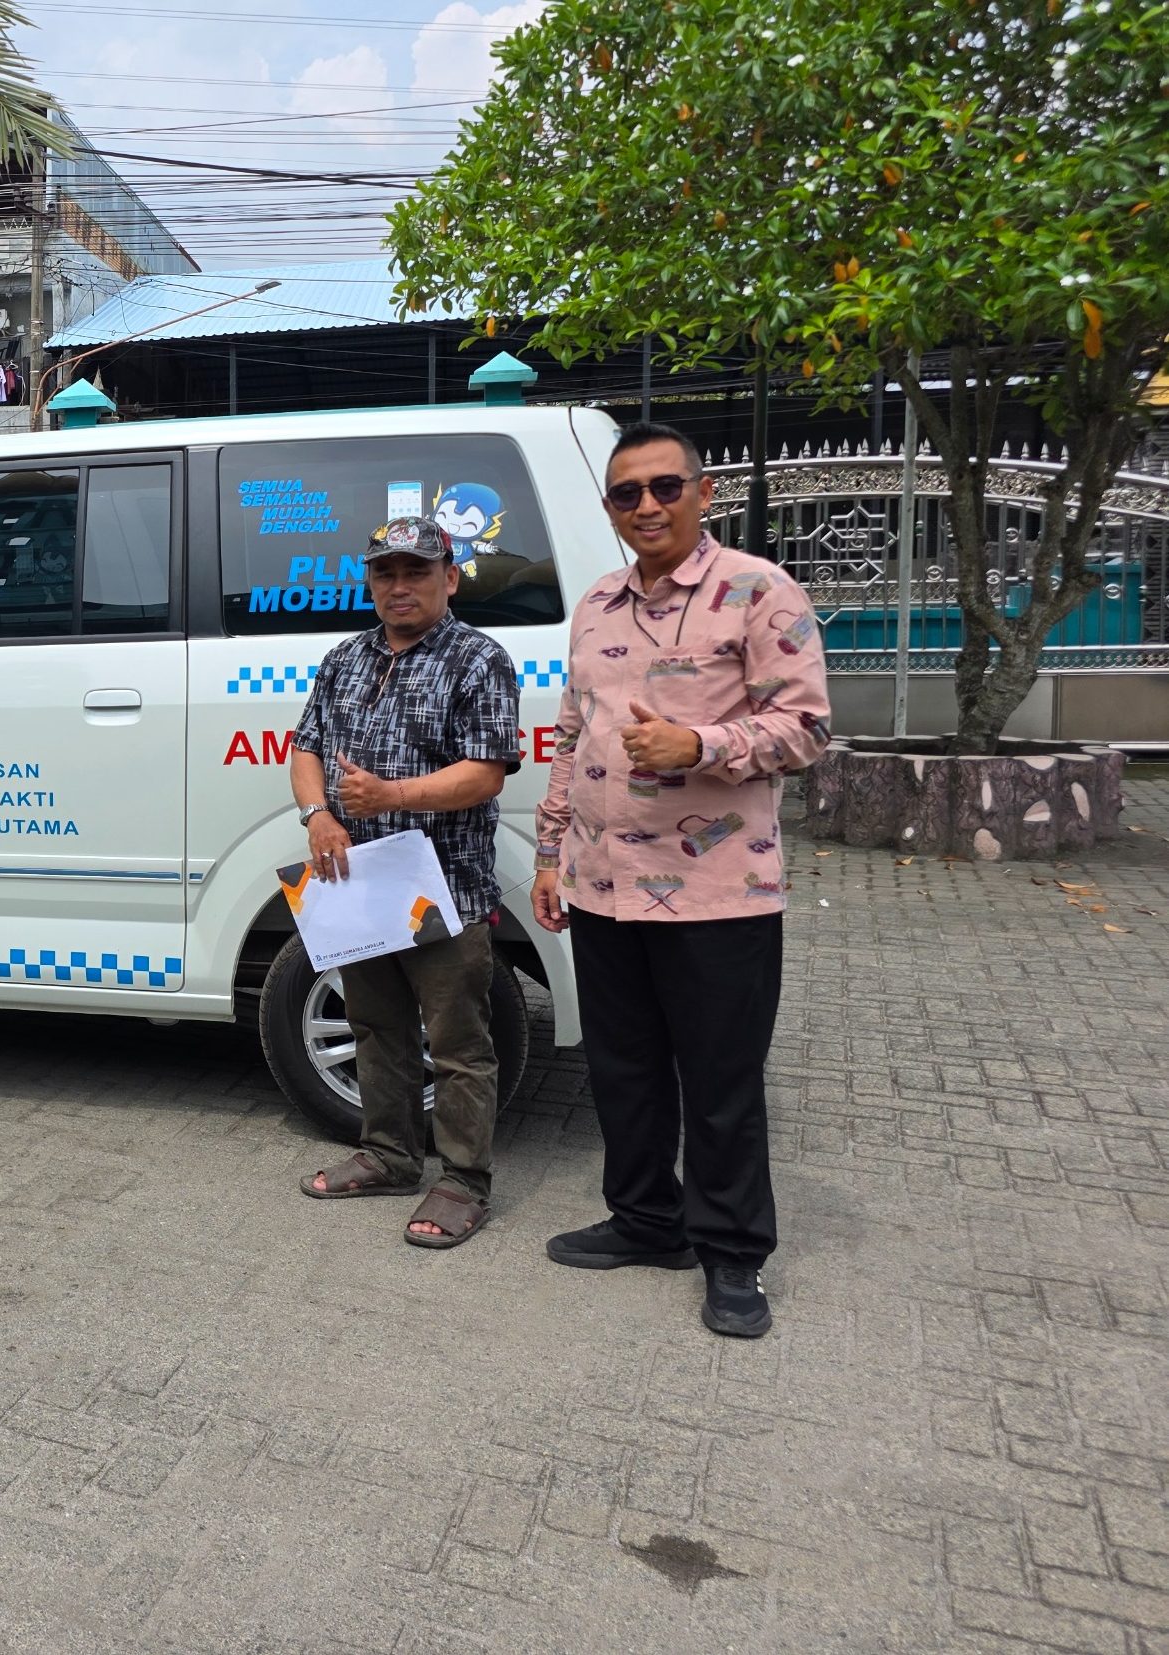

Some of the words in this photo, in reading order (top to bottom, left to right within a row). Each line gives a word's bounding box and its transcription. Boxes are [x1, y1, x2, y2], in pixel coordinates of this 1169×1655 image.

[238, 479, 303, 493] SEMUA
[240, 491, 328, 507] SEMAKIN
[261, 505, 333, 520] MUDAH
[259, 519, 340, 535] DENGAN
[288, 554, 366, 582] PLN
[249, 583, 375, 613] MOBIL
